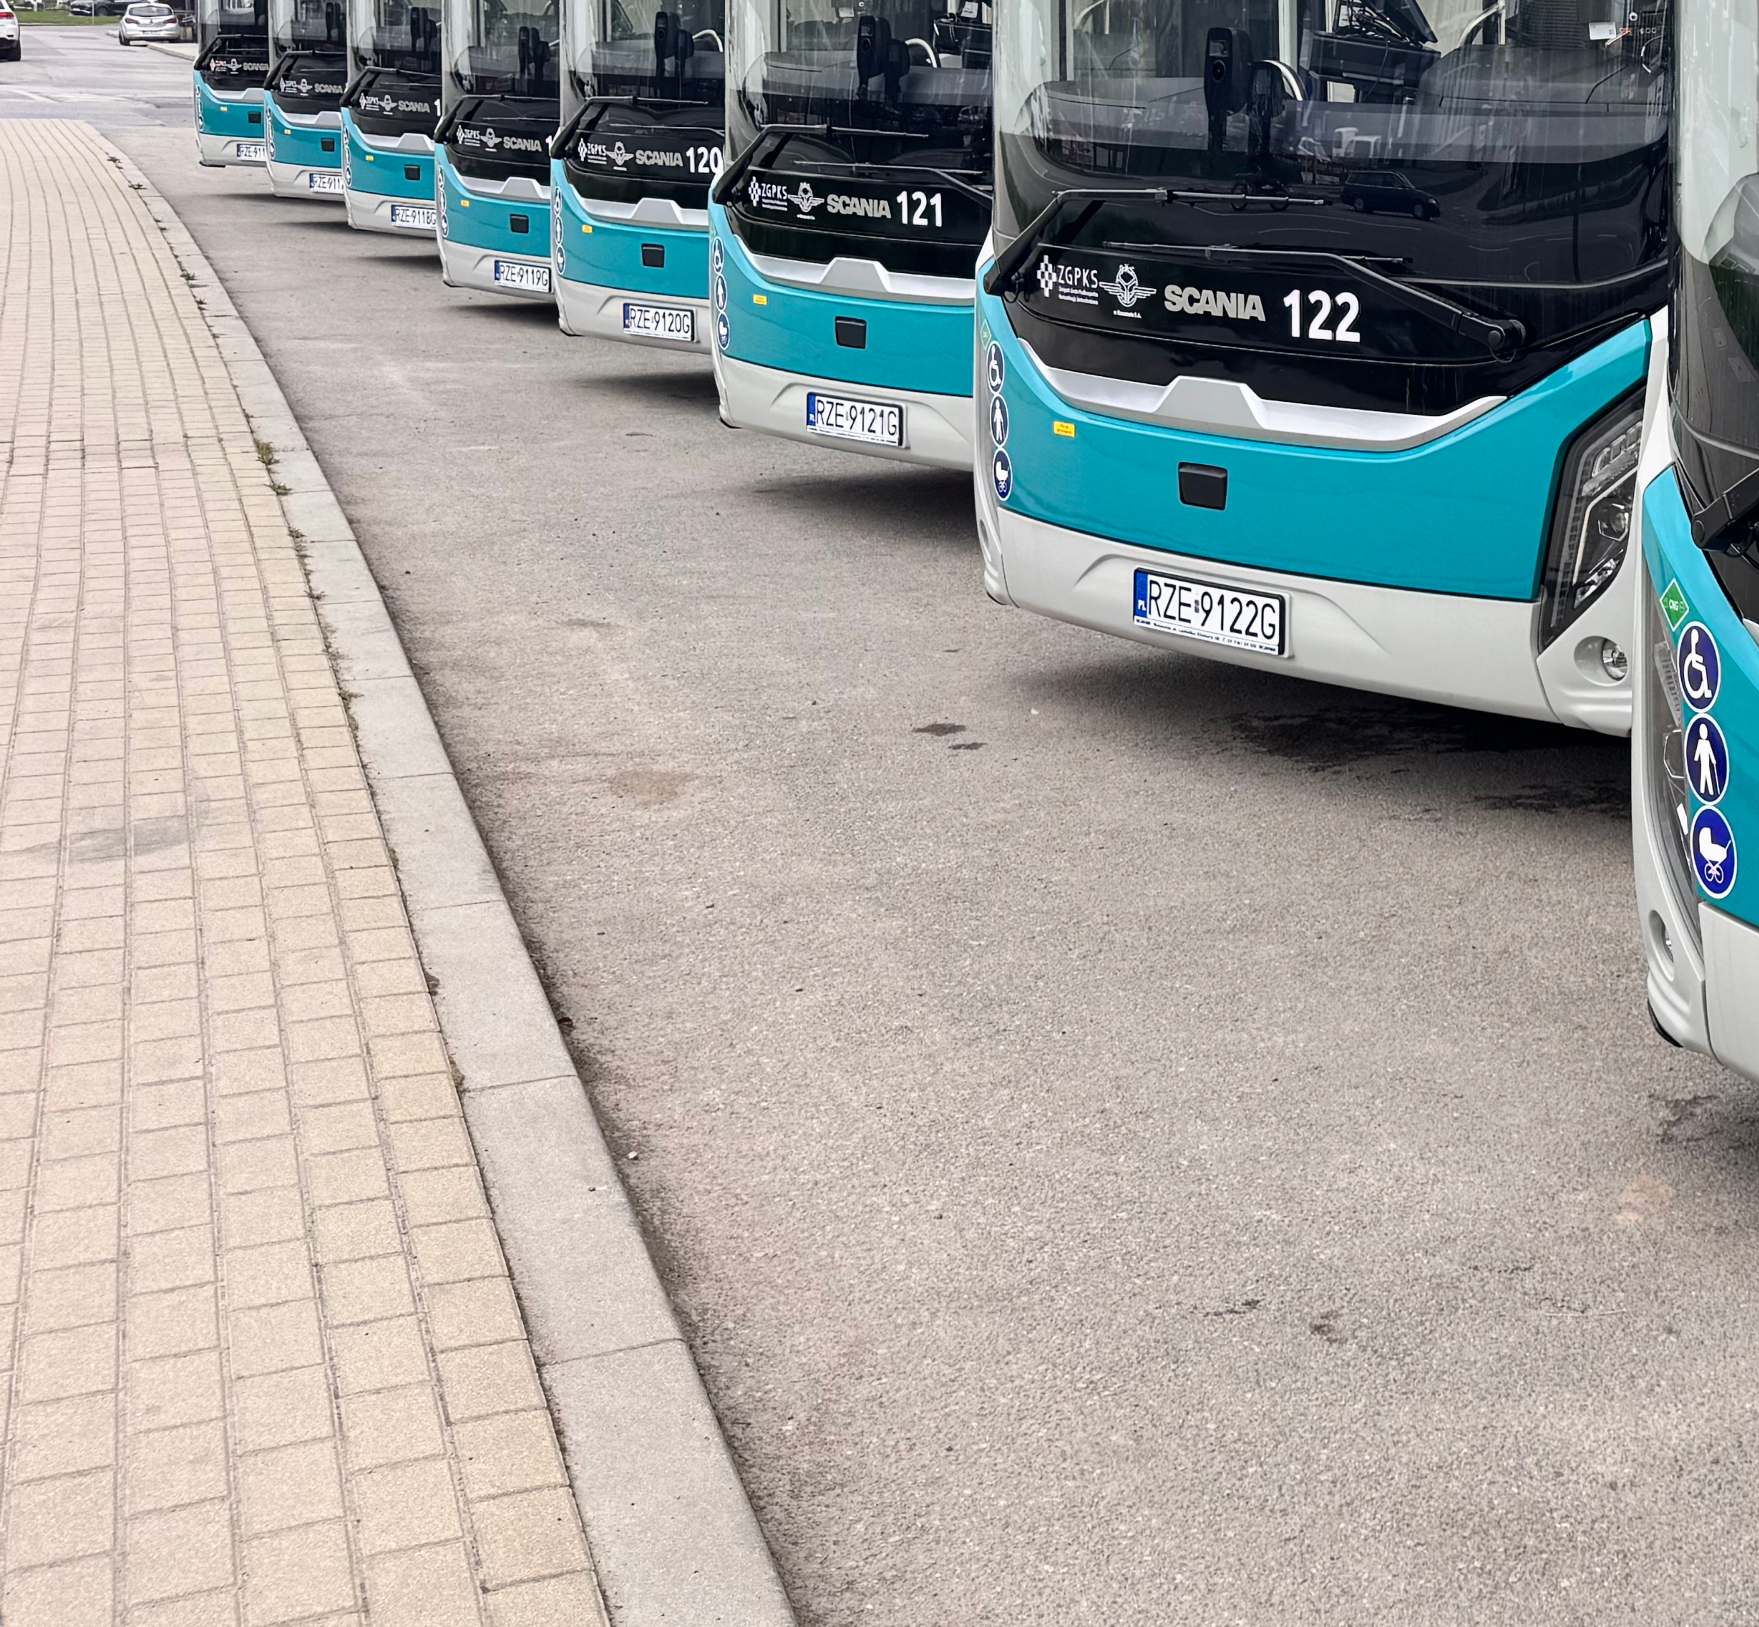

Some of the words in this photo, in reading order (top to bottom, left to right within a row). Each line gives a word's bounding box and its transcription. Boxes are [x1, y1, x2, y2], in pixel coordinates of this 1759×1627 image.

[398, 100, 431, 113] SCANIA
[503, 137, 542, 151] SCANIA
[635, 150, 684, 167] SCANIA
[686, 146, 723, 173] 120
[760, 183, 788, 200] ZGPKS
[826, 194, 892, 219] SCANIA
[896, 190, 943, 227] 121
[1057, 264, 1099, 289] ZGPKS
[630, 308, 651, 329] RZE
[654, 311, 690, 334] 9120G
[1164, 285, 1267, 322] SCANIA
[1283, 289, 1361, 343] 122
[816, 399, 845, 429] RZE
[849, 405, 897, 436] 9121G
[1149, 579, 1192, 624] RZE
[1200, 591, 1276, 640] 9122G
